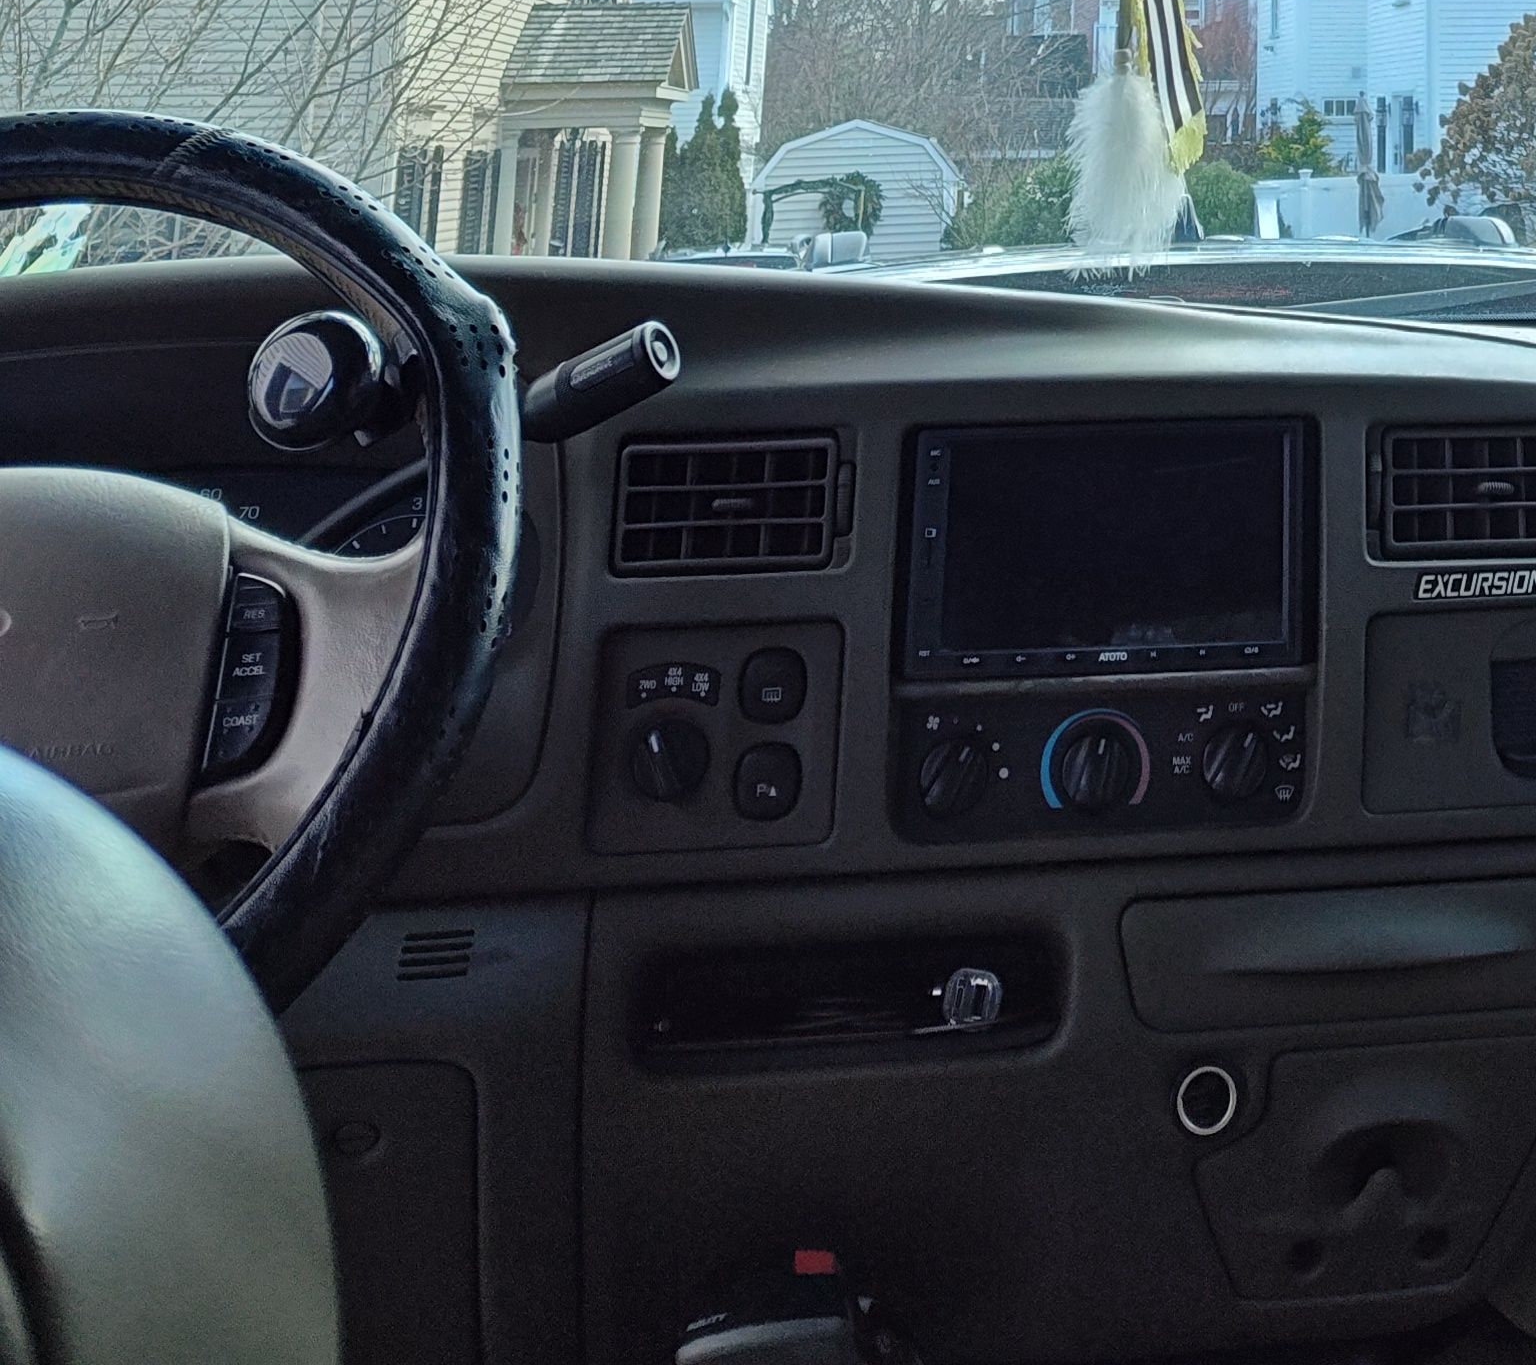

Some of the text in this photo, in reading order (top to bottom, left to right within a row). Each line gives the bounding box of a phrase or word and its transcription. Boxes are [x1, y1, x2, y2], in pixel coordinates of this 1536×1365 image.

[412, 497, 423, 510] 3
[239, 506, 260, 519] 70
[243, 609, 265, 619] RES
[241, 652, 262, 663] SET
[1098, 651, 1128, 662] ATOTO
[232, 665, 266, 677] ACCEL
[668, 668, 682, 676] 4X4
[664, 677, 684, 686] HIGH
[694, 673, 709, 682] 4X4
[639, 680, 656, 690] 2WD
[691, 682, 710, 692] LOW
[1228, 702, 1245, 712] OFF
[222, 714, 259, 727] COAST
[1178, 732, 1194, 742] A/C
[1172, 756, 1191, 765] MAX
[1174, 766, 1190, 774] A/C
